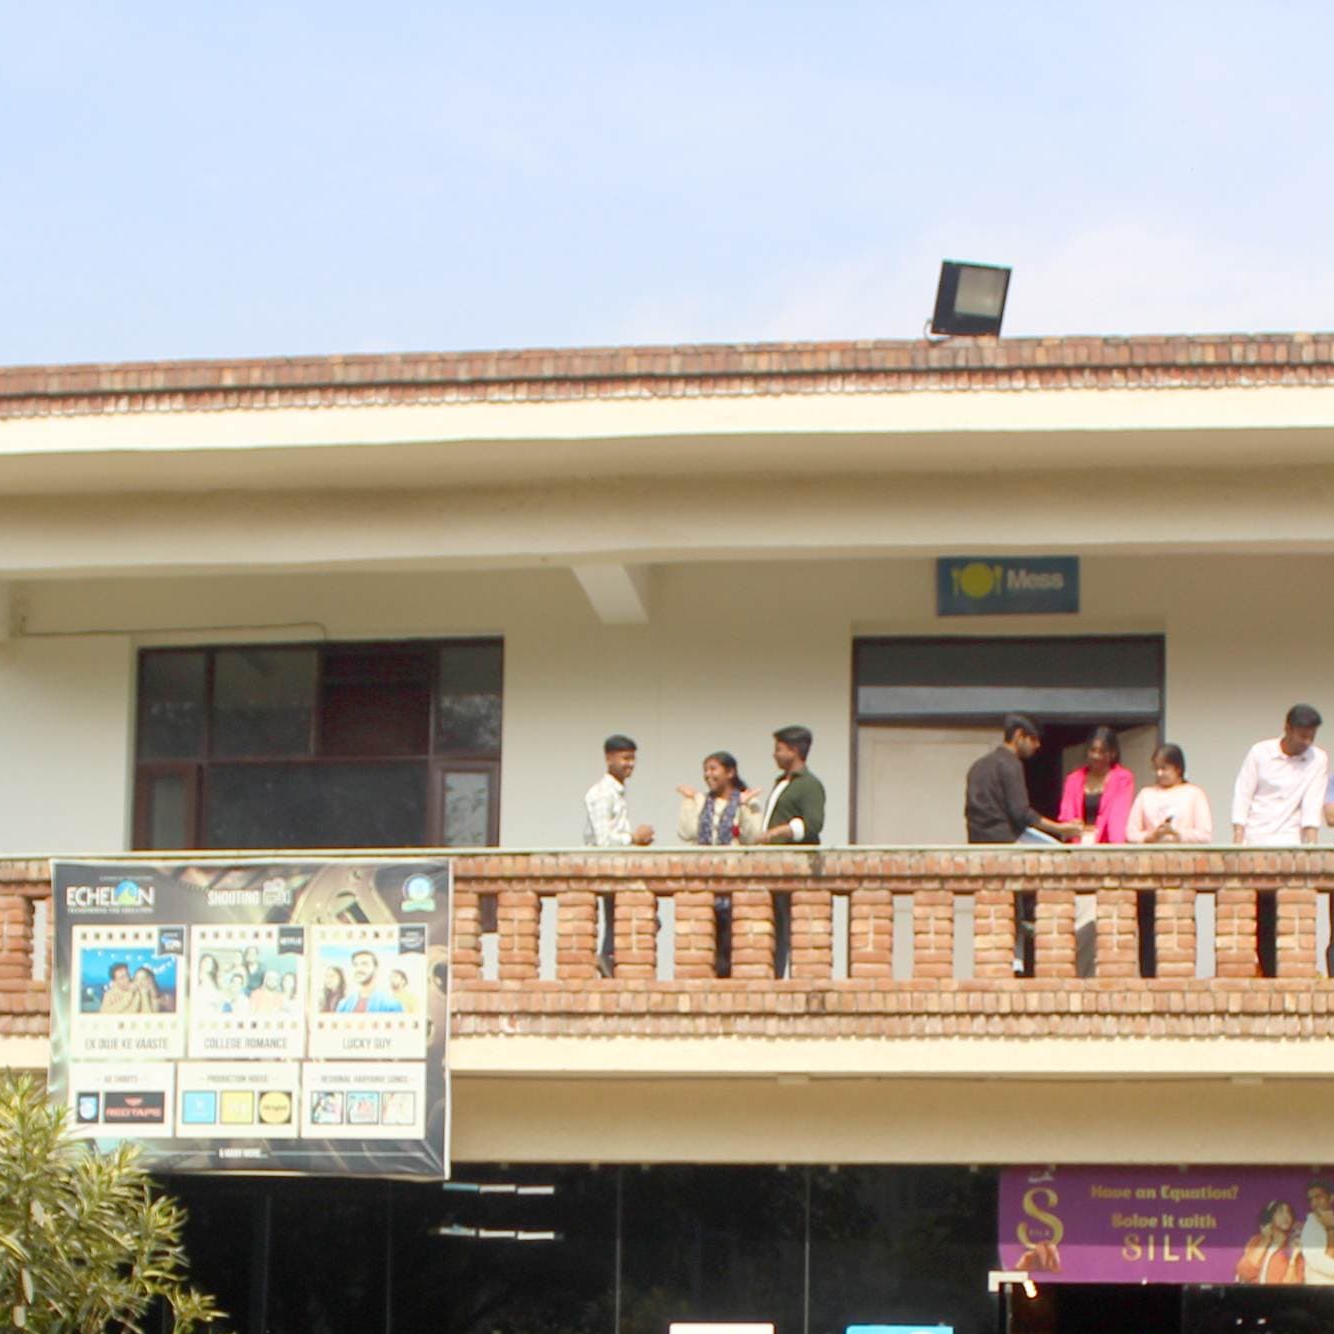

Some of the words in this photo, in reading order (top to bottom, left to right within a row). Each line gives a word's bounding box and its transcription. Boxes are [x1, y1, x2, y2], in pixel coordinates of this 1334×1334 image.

[1006, 568, 1064, 590] Mess
[66, 880, 155, 906] ECHELON
[207, 889, 260, 906] SHOOTING
[204, 1037, 241, 1049] COLLEGE
[244, 1037, 288, 1049] ROMANCE
[342, 1037, 370, 1050] LUCKY
[1091, 1184, 1131, 1199] Have
[1135, 1187, 1156, 1199] an
[1161, 1184, 1239, 1202] Equation?
[1178, 1213, 1216, 1229] with
[1122, 1234, 1206, 1262] SILK
